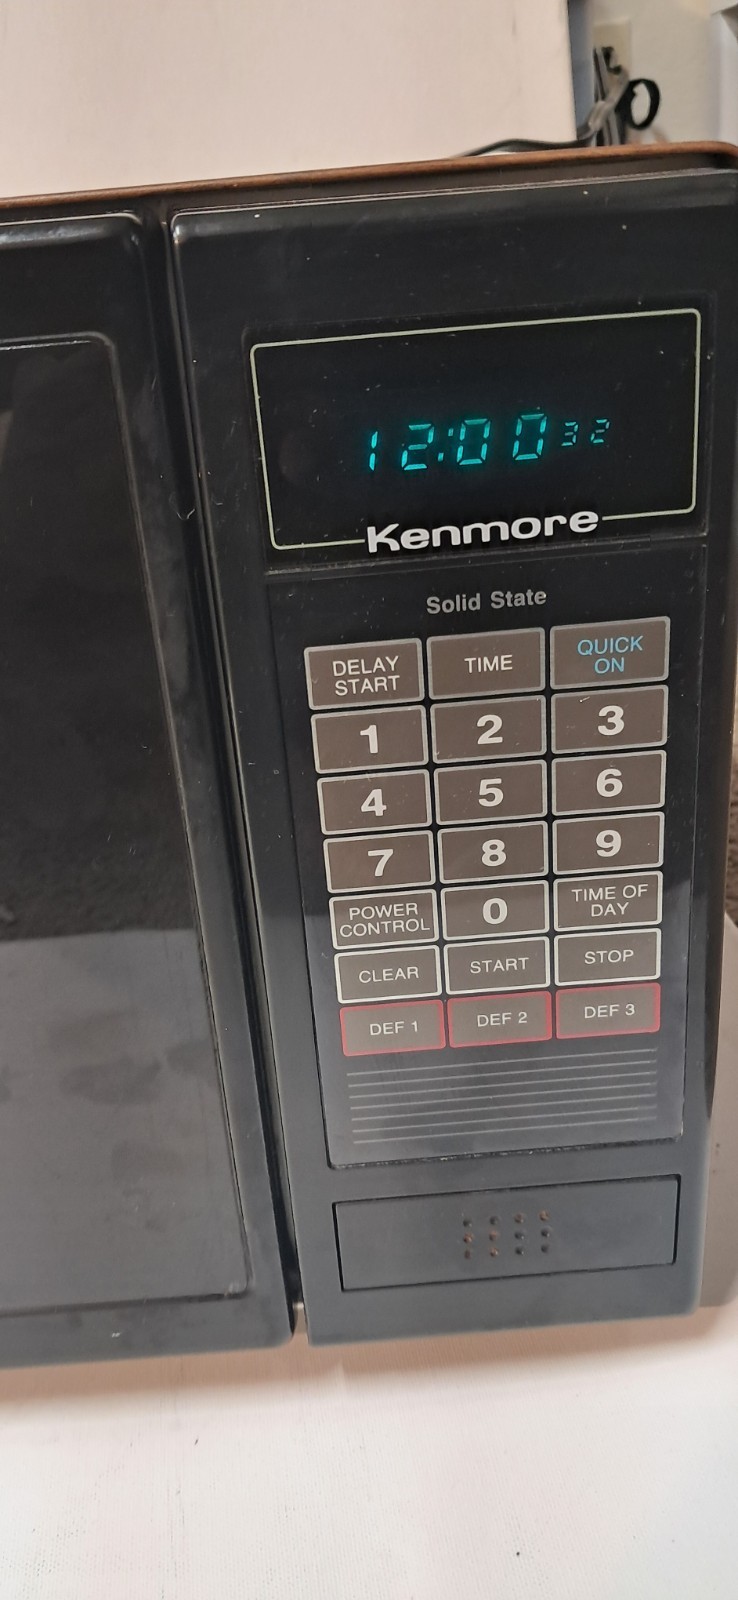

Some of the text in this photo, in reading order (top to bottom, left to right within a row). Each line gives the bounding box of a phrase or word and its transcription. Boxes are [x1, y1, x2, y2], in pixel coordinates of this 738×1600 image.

[369, 413, 548, 471] 12:00
[367, 510, 599, 553] Kenmore
[426, 589, 547, 615] Solid State
[577, 636, 643, 656] QUICK
[332, 655, 400, 677] DELAY
[464, 654, 513, 674] TIME
[594, 657, 625, 675] ON
[335, 675, 400, 696] START
[476, 714, 503, 745] 2
[597, 705, 625, 736] 3
[360, 725, 378, 754] 1
[478, 778, 504, 807] 5
[596, 768, 623, 797] 6
[360, 788, 387, 817] 4
[481, 839, 507, 867] 8
[595, 829, 622, 857] 9
[367, 848, 394, 877] 7
[571, 883, 648, 902] TIME OF
[349, 902, 418, 920] POWER
[483, 897, 508, 925] 0
[590, 902, 629, 918] DAY
[339, 917, 430, 938] CONTROL
[469, 957, 529, 974] START
[584, 949, 634, 964] STOP
[359, 966, 419, 984] CLEAR
[476, 1012, 528, 1028] DEF 2
[584, 1003, 635, 1019] DEF 3
[369, 1021, 418, 1036] DEF 1
